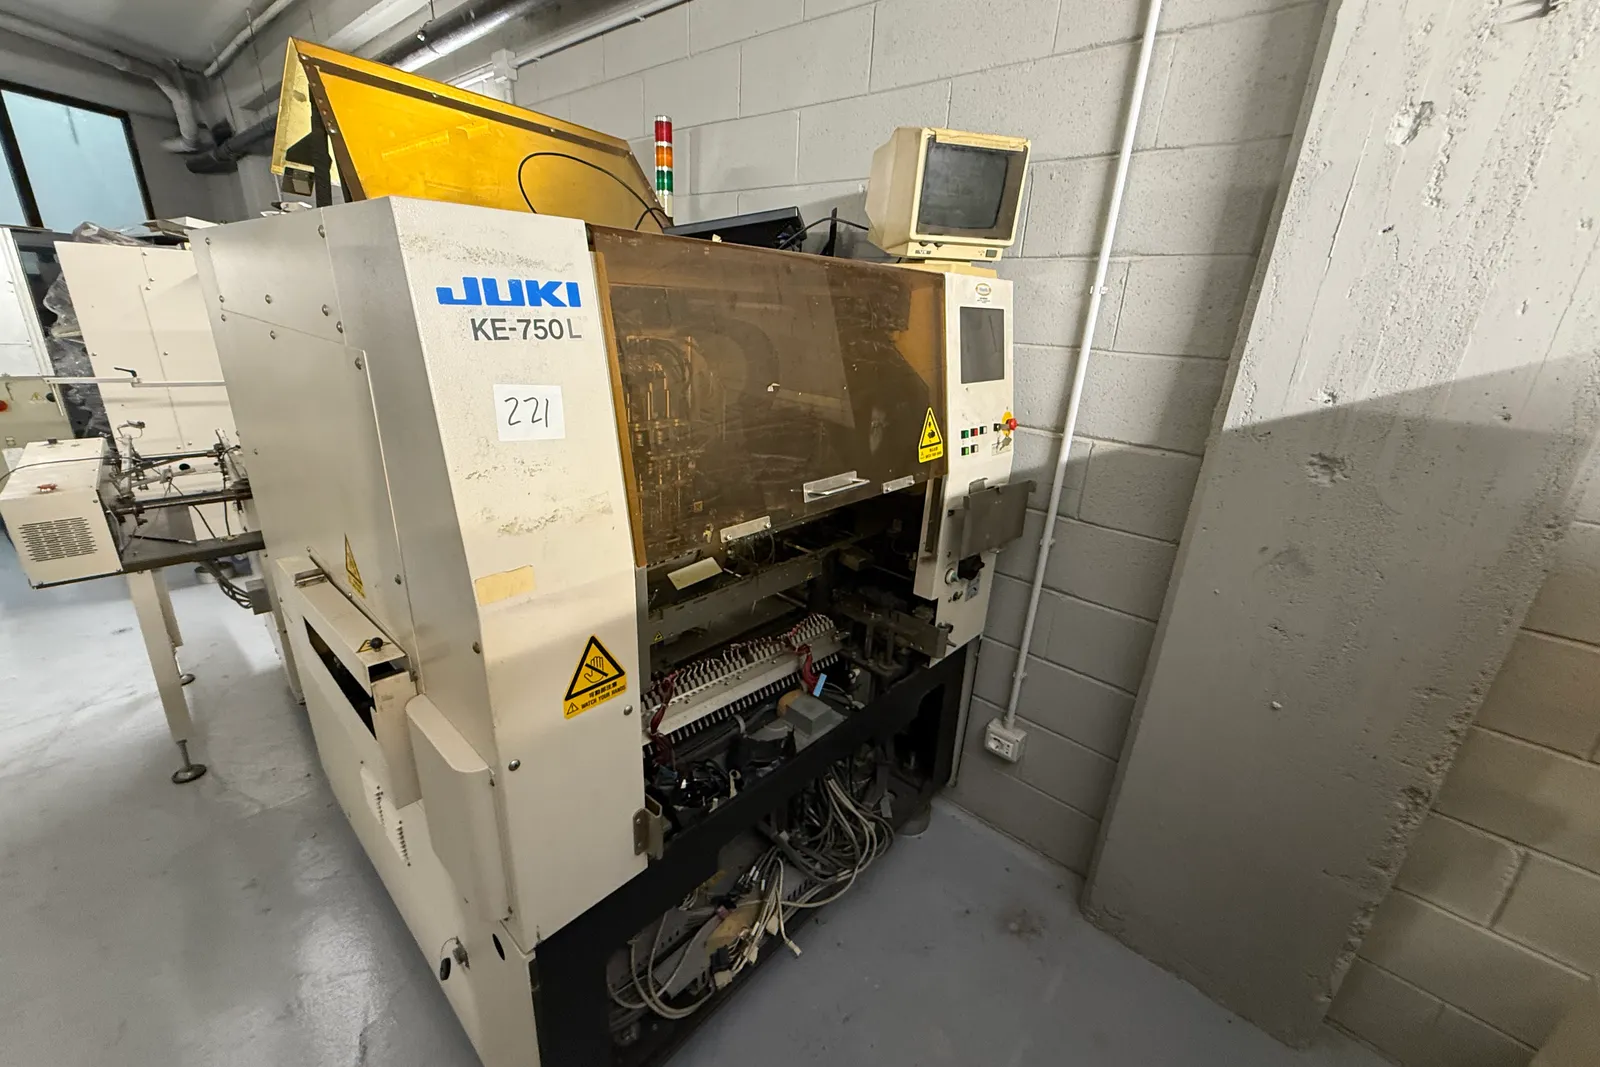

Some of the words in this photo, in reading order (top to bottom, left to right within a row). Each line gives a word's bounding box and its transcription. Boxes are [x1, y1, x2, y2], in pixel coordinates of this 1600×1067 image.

[436, 277, 581, 307] JUKI
[504, 397, 549, 428] 221
[581, 698, 597, 709] WATCH
[598, 692, 610, 701] YOUR
